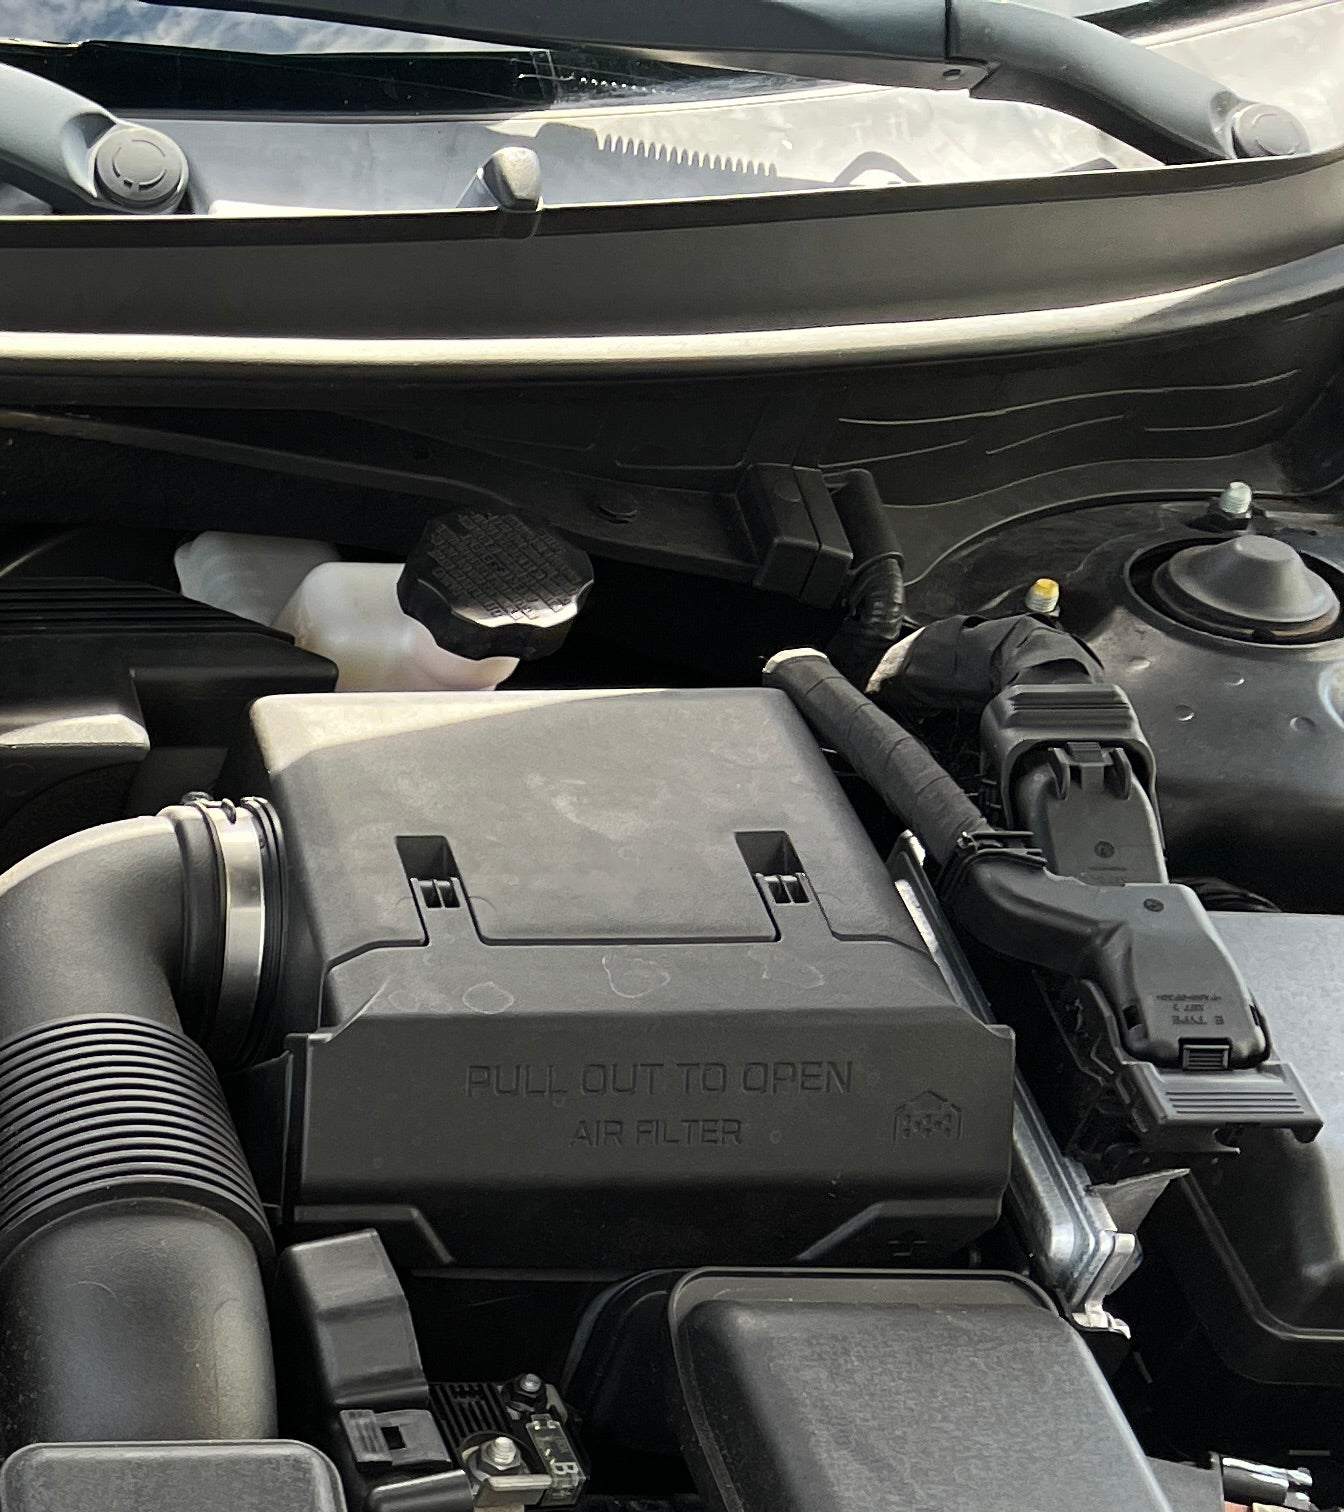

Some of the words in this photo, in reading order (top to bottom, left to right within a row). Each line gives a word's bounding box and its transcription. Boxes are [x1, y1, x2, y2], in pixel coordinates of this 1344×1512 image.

[465, 1062, 568, 1098] PULL
[578, 1062, 665, 1096] OUT
[676, 1061, 727, 1096] TO
[741, 1060, 855, 1095] OPEN
[570, 1118, 623, 1147] AIR
[635, 1117, 743, 1146] FILTER
